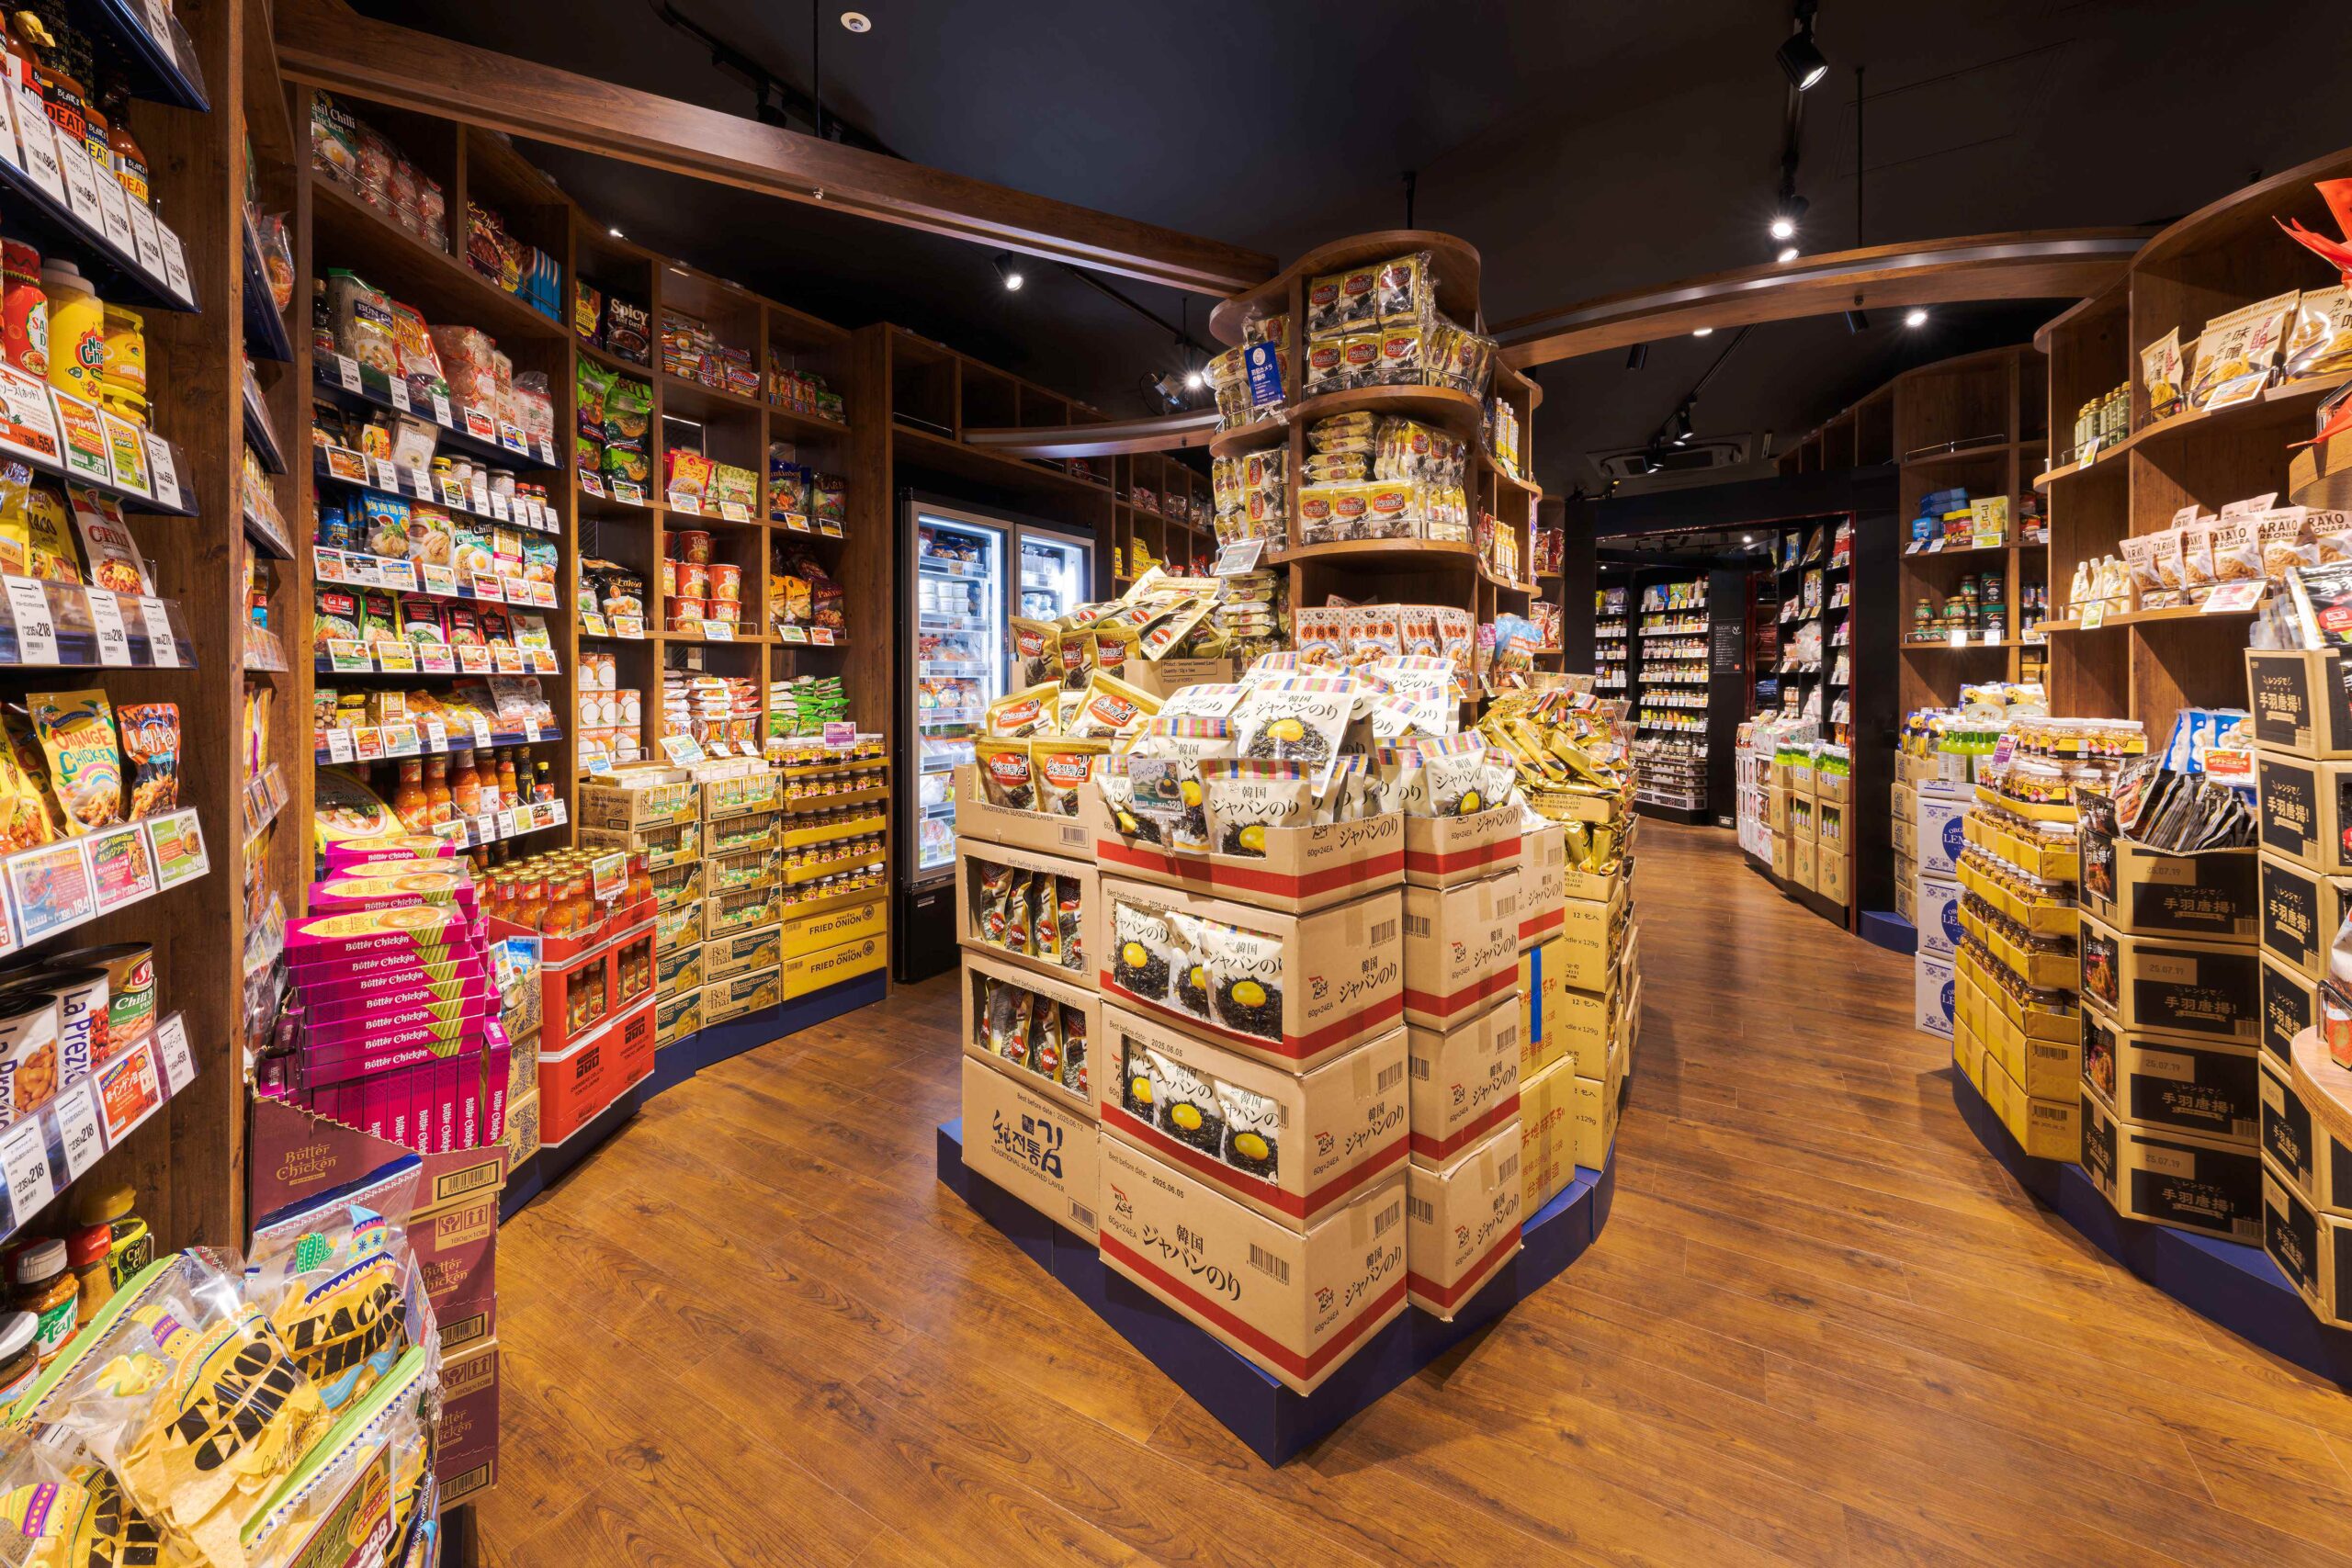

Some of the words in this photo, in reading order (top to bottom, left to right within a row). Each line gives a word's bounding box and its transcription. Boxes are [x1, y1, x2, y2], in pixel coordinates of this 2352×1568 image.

[312, 103, 328, 118] asil
[330, 108, 356, 130] Chilli
[610, 298, 649, 327] Spicy
[39, 434, 55, 456] 554
[88, 525, 130, 548] CHILI
[456, 533, 485, 544] Chicken
[474, 523, 492, 535] Chilli
[37, 623, 51, 637] 218
[112, 629, 123, 643] 218
[1256, 702, 1339, 721] ジャバンのり
[51, 728, 111, 750] ORANGE
[1178, 744, 1200, 756] 韓国
[59, 748, 119, 774] CHICKEN
[1242, 786, 1268, 798] 韓国
[1213, 799, 1300, 818] ジャバンのり
[1340, 818, 1398, 849] ジャバンのり
[74, 898, 90, 916] 184
[809, 922, 834, 935] FRIED
[835, 916, 862, 930] ONION
[374, 935, 410, 948] Chicken
[1490, 927, 1503, 944] 韓国
[1583, 939, 1599, 948] 129g
[712, 946, 729, 956] Roi
[1235, 942, 1259, 955] 韓国
[1474, 935, 1517, 970] ジャバンのり
[380, 953, 415, 967] Chicken
[709, 953, 731, 966] Thai
[810, 961, 834, 974] FRIED
[836, 952, 862, 966] ONION
[1362, 955, 1378, 974] 韓国
[389, 972, 424, 985] Chicken
[1340, 961, 1397, 1003] ジャバンのり
[64, 988, 92, 1017] La
[116, 992, 146, 1010] Chili
[394, 990, 430, 1004] Chicken
[710, 988, 727, 999] Roi
[707, 998, 729, 1010] Thai
[393, 1010, 429, 1025] Chicken
[393, 1030, 429, 1044] Chicken
[1110, 1020, 1119, 1030] Best
[1119, 1023, 1135, 1036] before
[1151, 1038, 1183, 1057] 2025.06.05
[1583, 1026, 1599, 1036] 129g
[392, 1049, 428, 1064] Chicken
[1490, 1060, 1502, 1078] 韓国
[1473, 1064, 1517, 1107] ジャバンのり
[1367, 1101, 1385, 1122] 韓国
[1580, 1115, 1597, 1126] 129g
[81, 1123, 95, 1144] 218
[1345, 1104, 1405, 1156] ジャバンのり
[285, 1143, 331, 1163] Butter
[29, 1163, 44, 1184] 218
[277, 1156, 338, 1181] Chicken
[990, 1145, 1020, 1168] TRADITIONAL
[1020, 1164, 1047, 1183] SEASONED
[1047, 1179, 1065, 1192] LAVER
[1108, 1151, 1119, 1164] Best
[1119, 1158, 1135, 1172] before
[1152, 1176, 1185, 1200] 2025.06.05
[1493, 1192, 1505, 1213] 韓国
[1477, 1193, 1520, 1246] ジャバンのり
[1176, 1224, 1204, 1255] 韓国
[1142, 1224, 1241, 1302] ジャバンのり
[1365, 1246, 1384, 1269] 韓国
[1345, 1246, 1402, 1308] ジャバンのり
